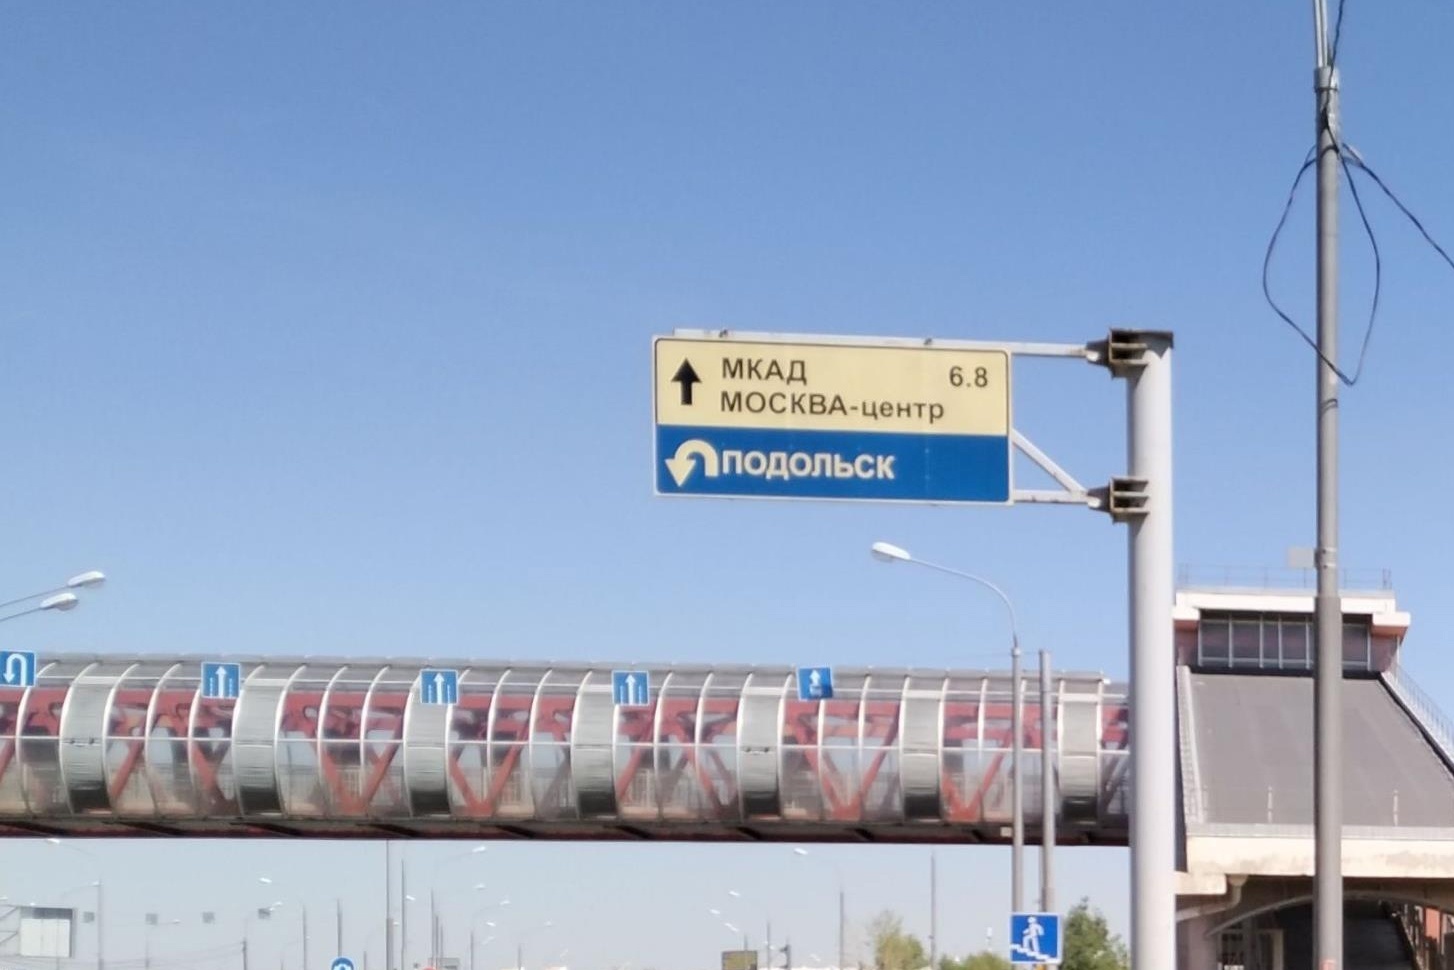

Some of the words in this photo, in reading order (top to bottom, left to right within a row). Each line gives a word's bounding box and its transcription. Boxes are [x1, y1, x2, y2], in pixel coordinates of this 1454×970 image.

[721, 357, 807, 384] МКАД
[949, 366, 989, 388] 6.8
[720, 391, 945, 423] МОСКВА-центр
[722, 449, 896, 480] ПОДОЛЬСК
